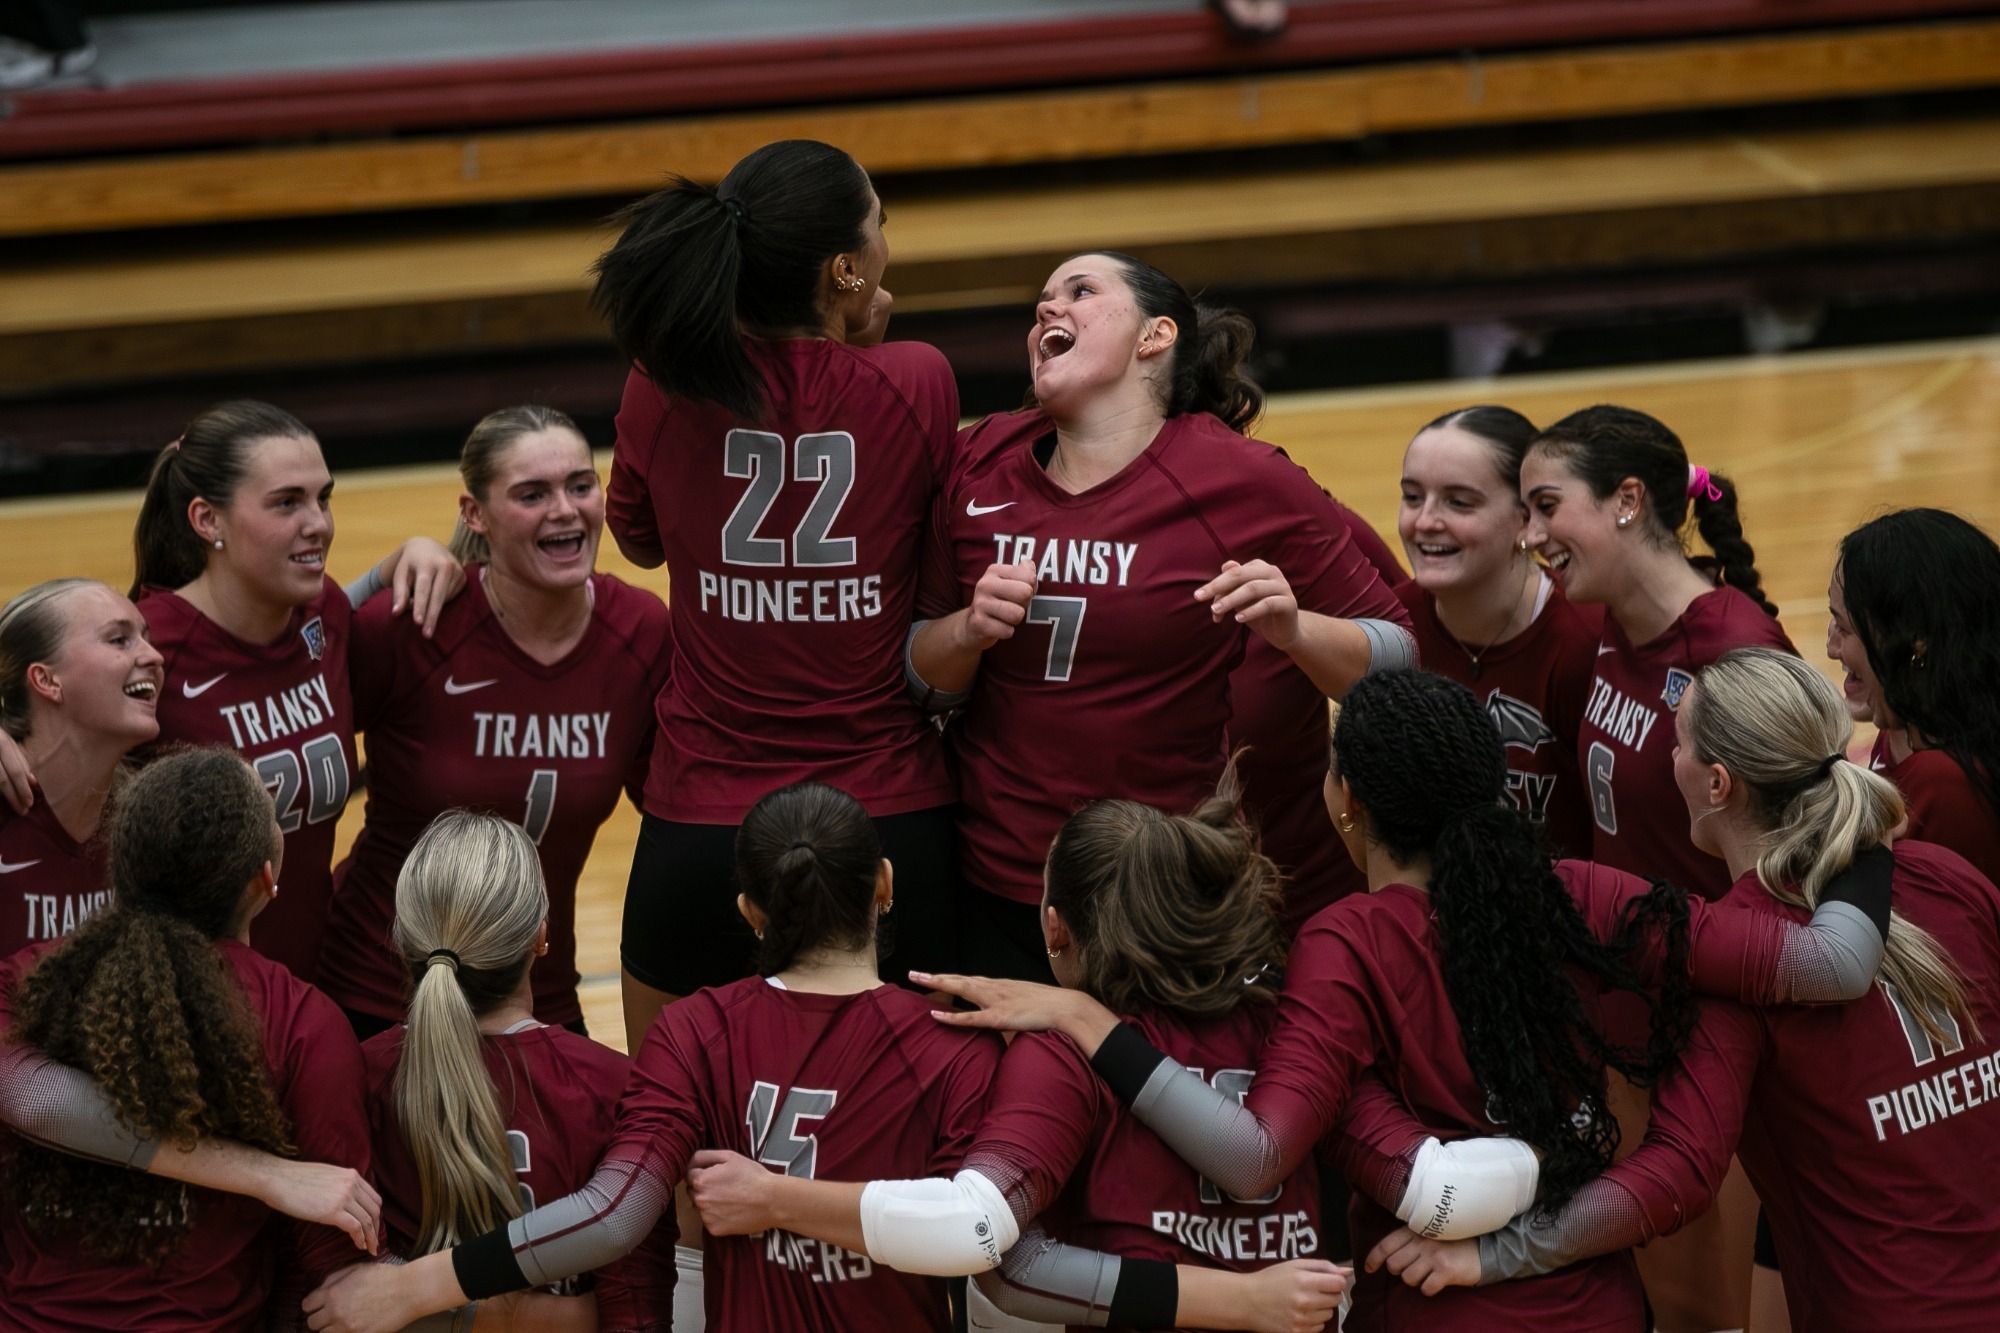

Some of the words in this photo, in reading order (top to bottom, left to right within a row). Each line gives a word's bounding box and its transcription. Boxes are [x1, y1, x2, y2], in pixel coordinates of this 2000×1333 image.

[721, 427, 857, 567] 22
[699, 569, 882, 623] PIONEERS
[992, 532, 1139, 586] TRANSY
[1026, 595, 1087, 681] 7
[219, 672, 335, 749] TRANSY
[473, 711, 611, 758] TRANSY
[1584, 675, 1658, 752] TRANSY
[253, 731, 350, 834] 20
[524, 769, 558, 846] 1
[1587, 740, 1617, 836] 6
[1152, 1209, 1318, 1260] PIONEERS
